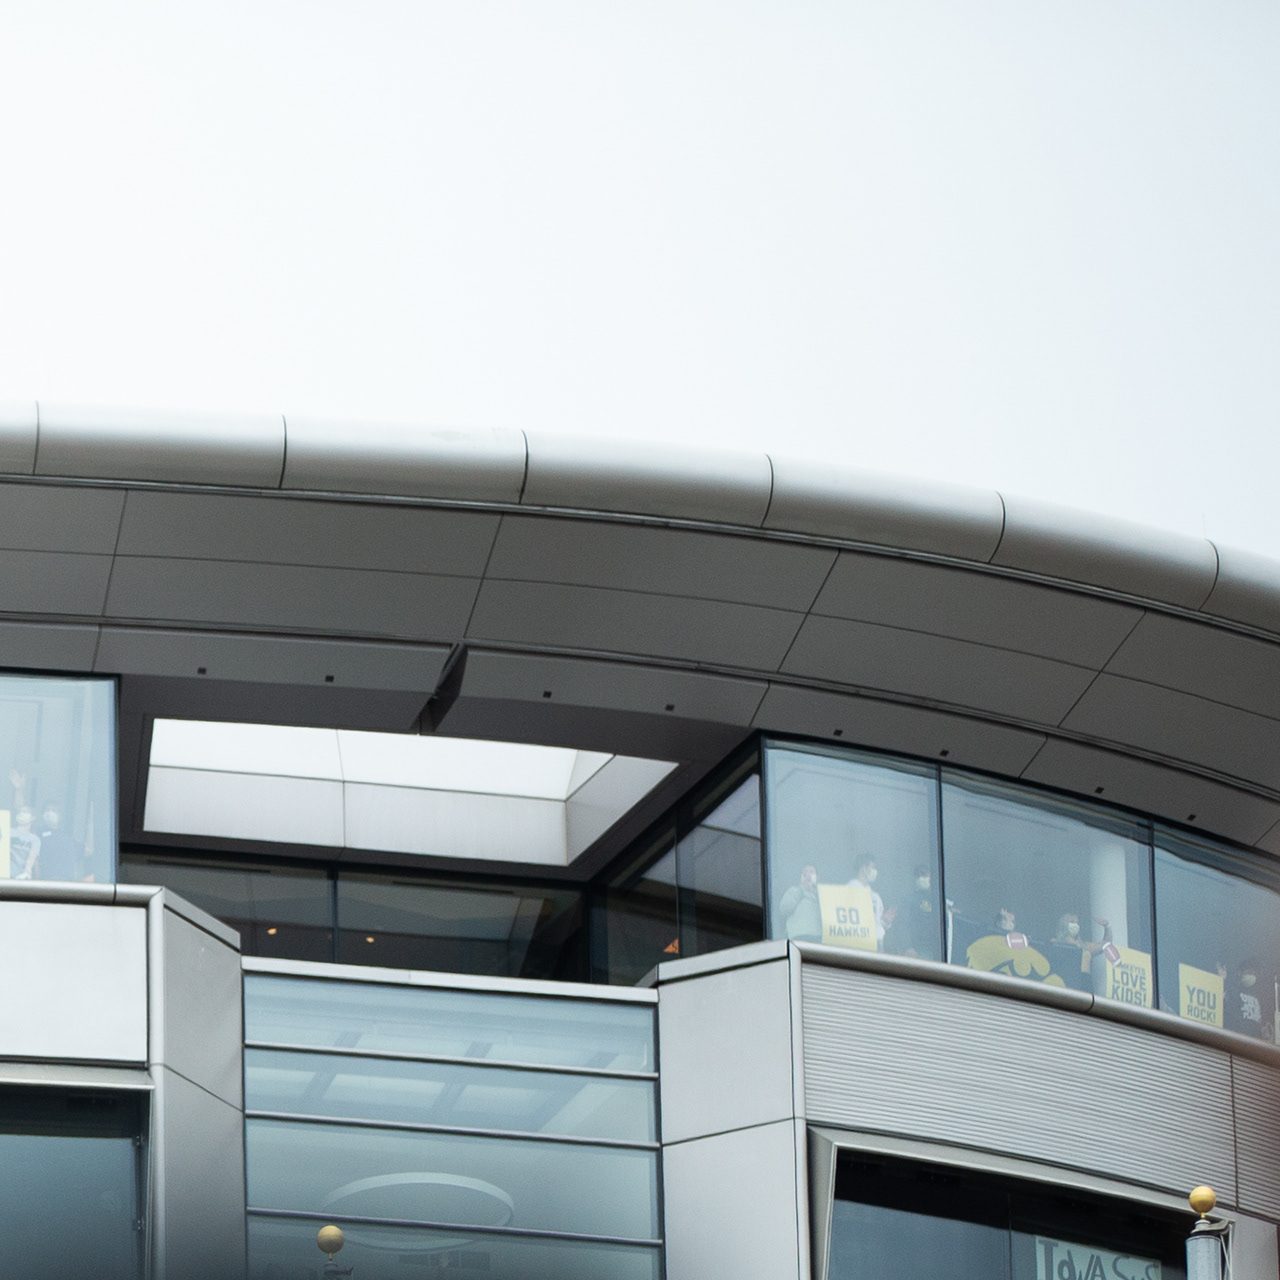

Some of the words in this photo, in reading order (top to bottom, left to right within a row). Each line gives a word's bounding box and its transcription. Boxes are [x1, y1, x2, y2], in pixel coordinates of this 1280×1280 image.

[835, 906, 861, 925] GO
[828, 924, 870, 938] HAWKS!
[1112, 967, 1147, 992] LOVE
[1111, 984, 1148, 1008] KIDS!
[1186, 985, 1217, 1011] YOU
[1187, 1004, 1217, 1024] ROCK!
